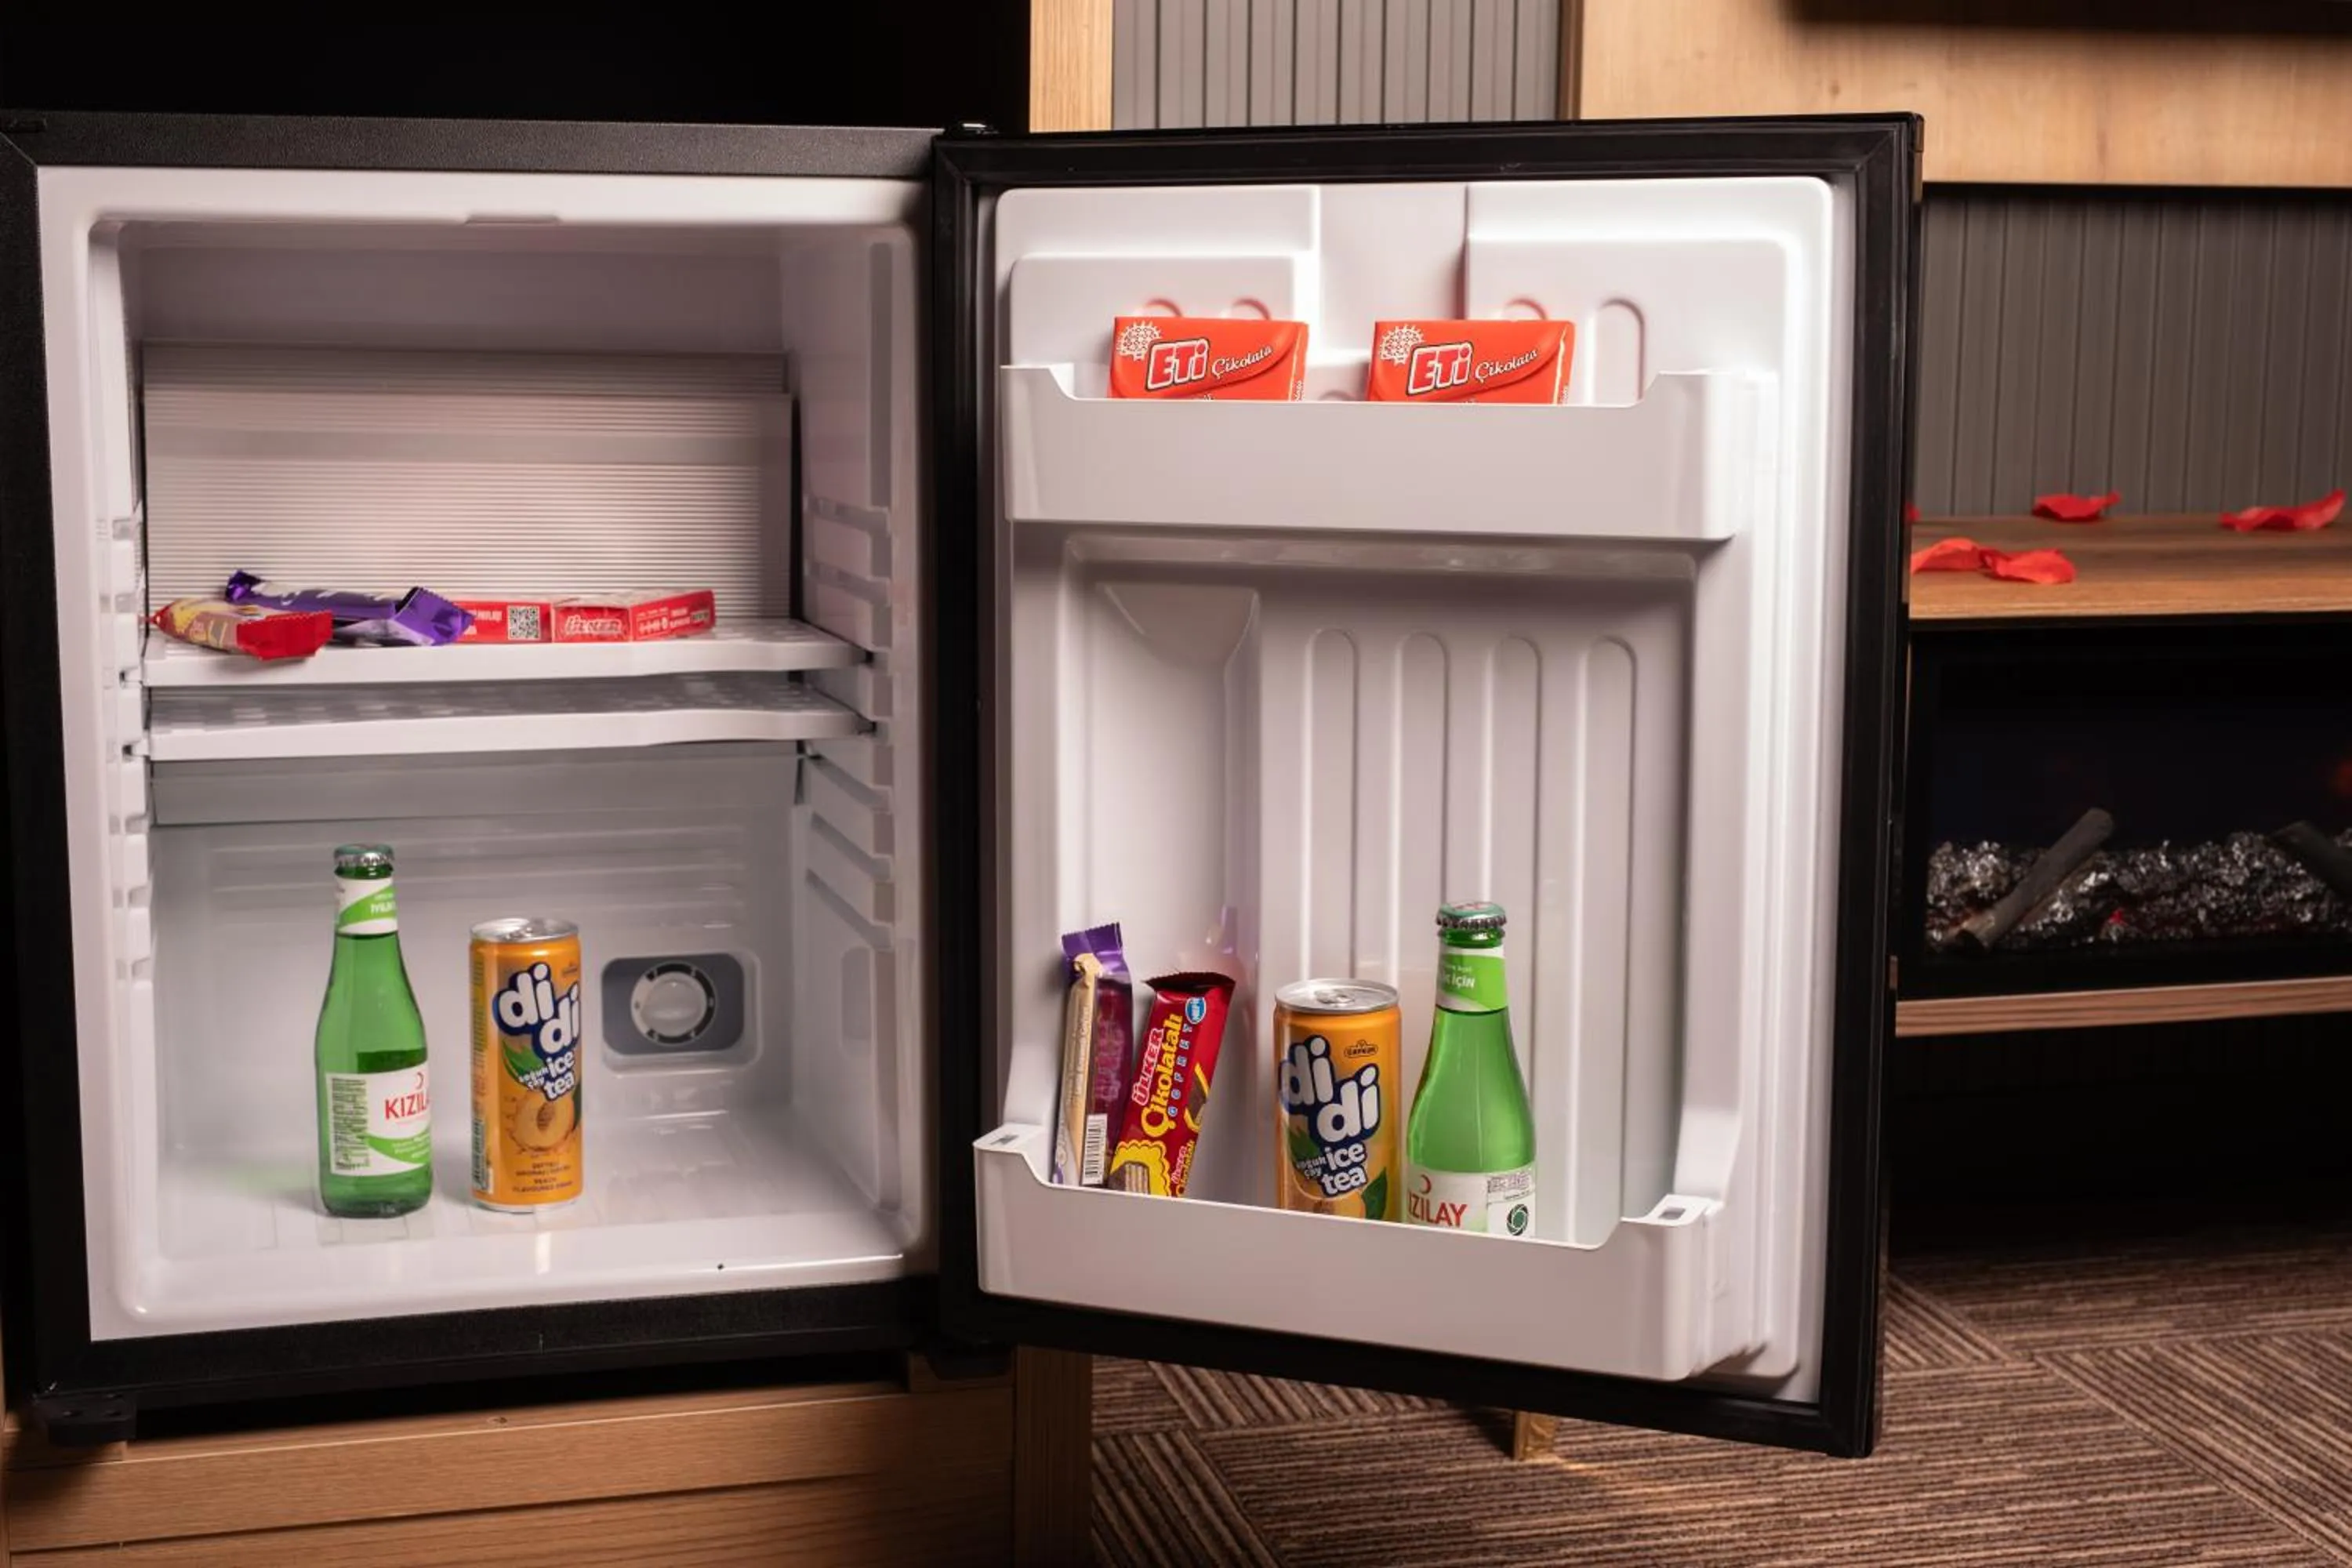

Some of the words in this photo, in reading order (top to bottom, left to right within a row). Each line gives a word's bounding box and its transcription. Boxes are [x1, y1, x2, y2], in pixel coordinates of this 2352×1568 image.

[1211, 345, 1272, 379] Çikolata
[1475, 348, 1537, 383] Çikolata
[499, 963, 555, 1029] di
[546, 1051, 575, 1078] ice
[1141, 1013, 1183, 1138] Çikolatalı
[1282, 1037, 1334, 1106] di
[544, 1071, 575, 1099] tea
[1316, 1065, 1379, 1143] di
[1324, 1142, 1365, 1171] ice
[1321, 1167, 1367, 1195] tea
[1407, 1190, 1468, 1228] IZILAY
